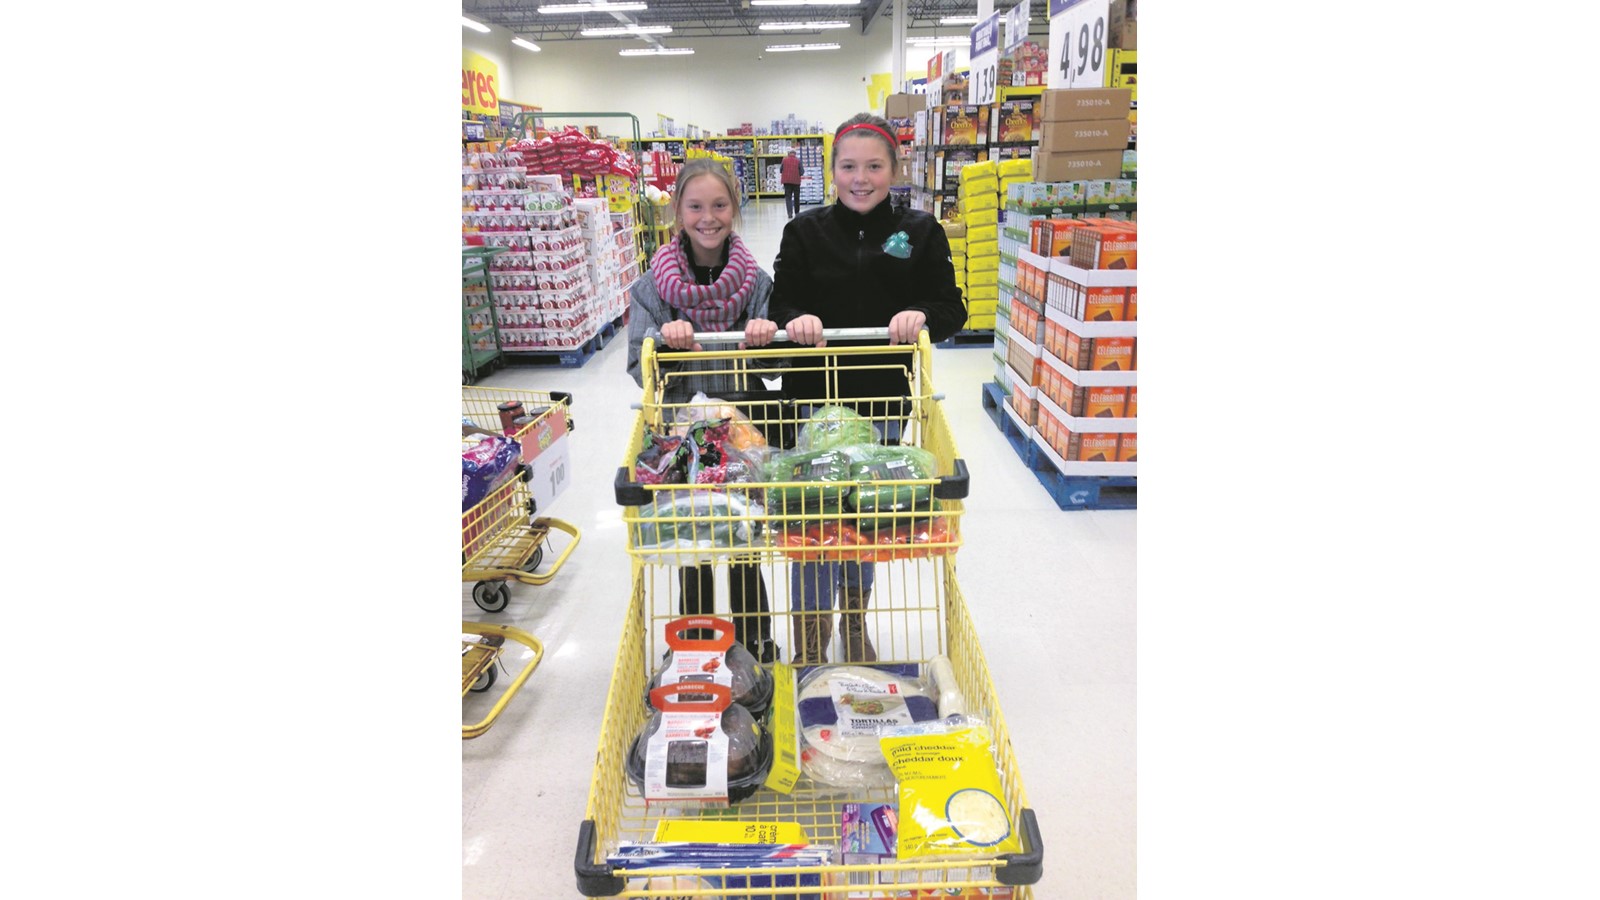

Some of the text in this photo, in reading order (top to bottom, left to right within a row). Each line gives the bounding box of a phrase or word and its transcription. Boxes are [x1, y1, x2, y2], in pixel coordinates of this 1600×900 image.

[1060, 17, 1104, 83] 4,98
[1077, 99, 1111, 107] 735010-A
[1075, 129, 1109, 138] 735010-A
[1068, 160, 1102, 168] 735010-A
[892, 756, 935, 767] cheddar
[769, 824, 779, 844] crèm
